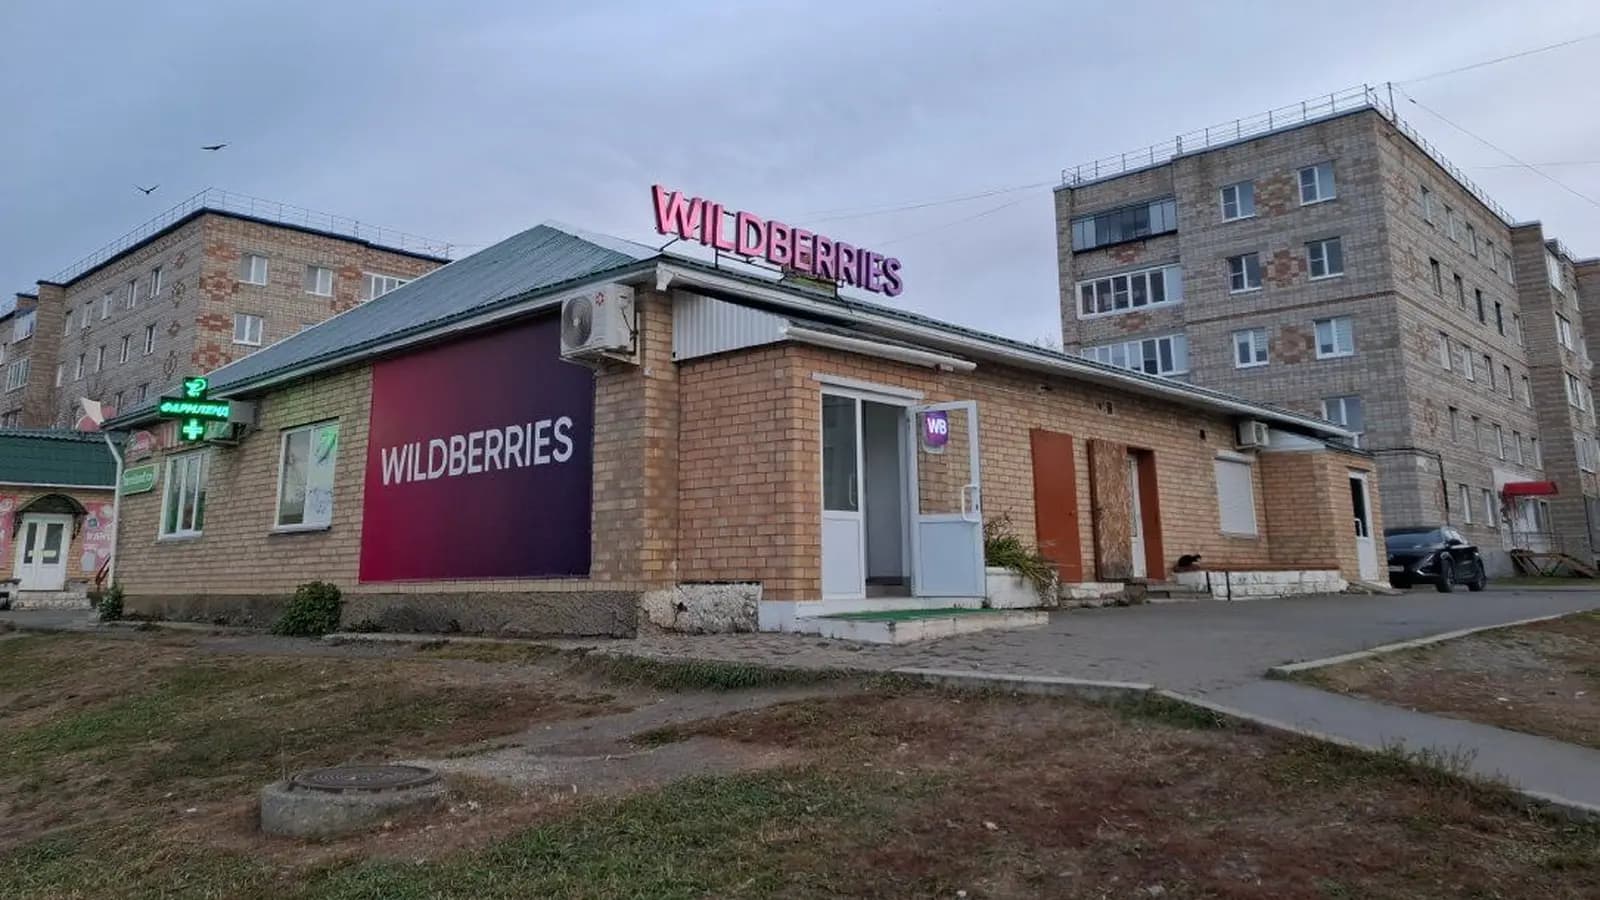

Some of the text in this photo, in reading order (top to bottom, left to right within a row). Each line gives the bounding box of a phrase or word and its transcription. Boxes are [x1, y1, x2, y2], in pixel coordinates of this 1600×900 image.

[652, 184, 903, 297] WILDBERRIES
[381, 417, 573, 486] WILDBERRIES
[927, 417, 947, 435] WB
